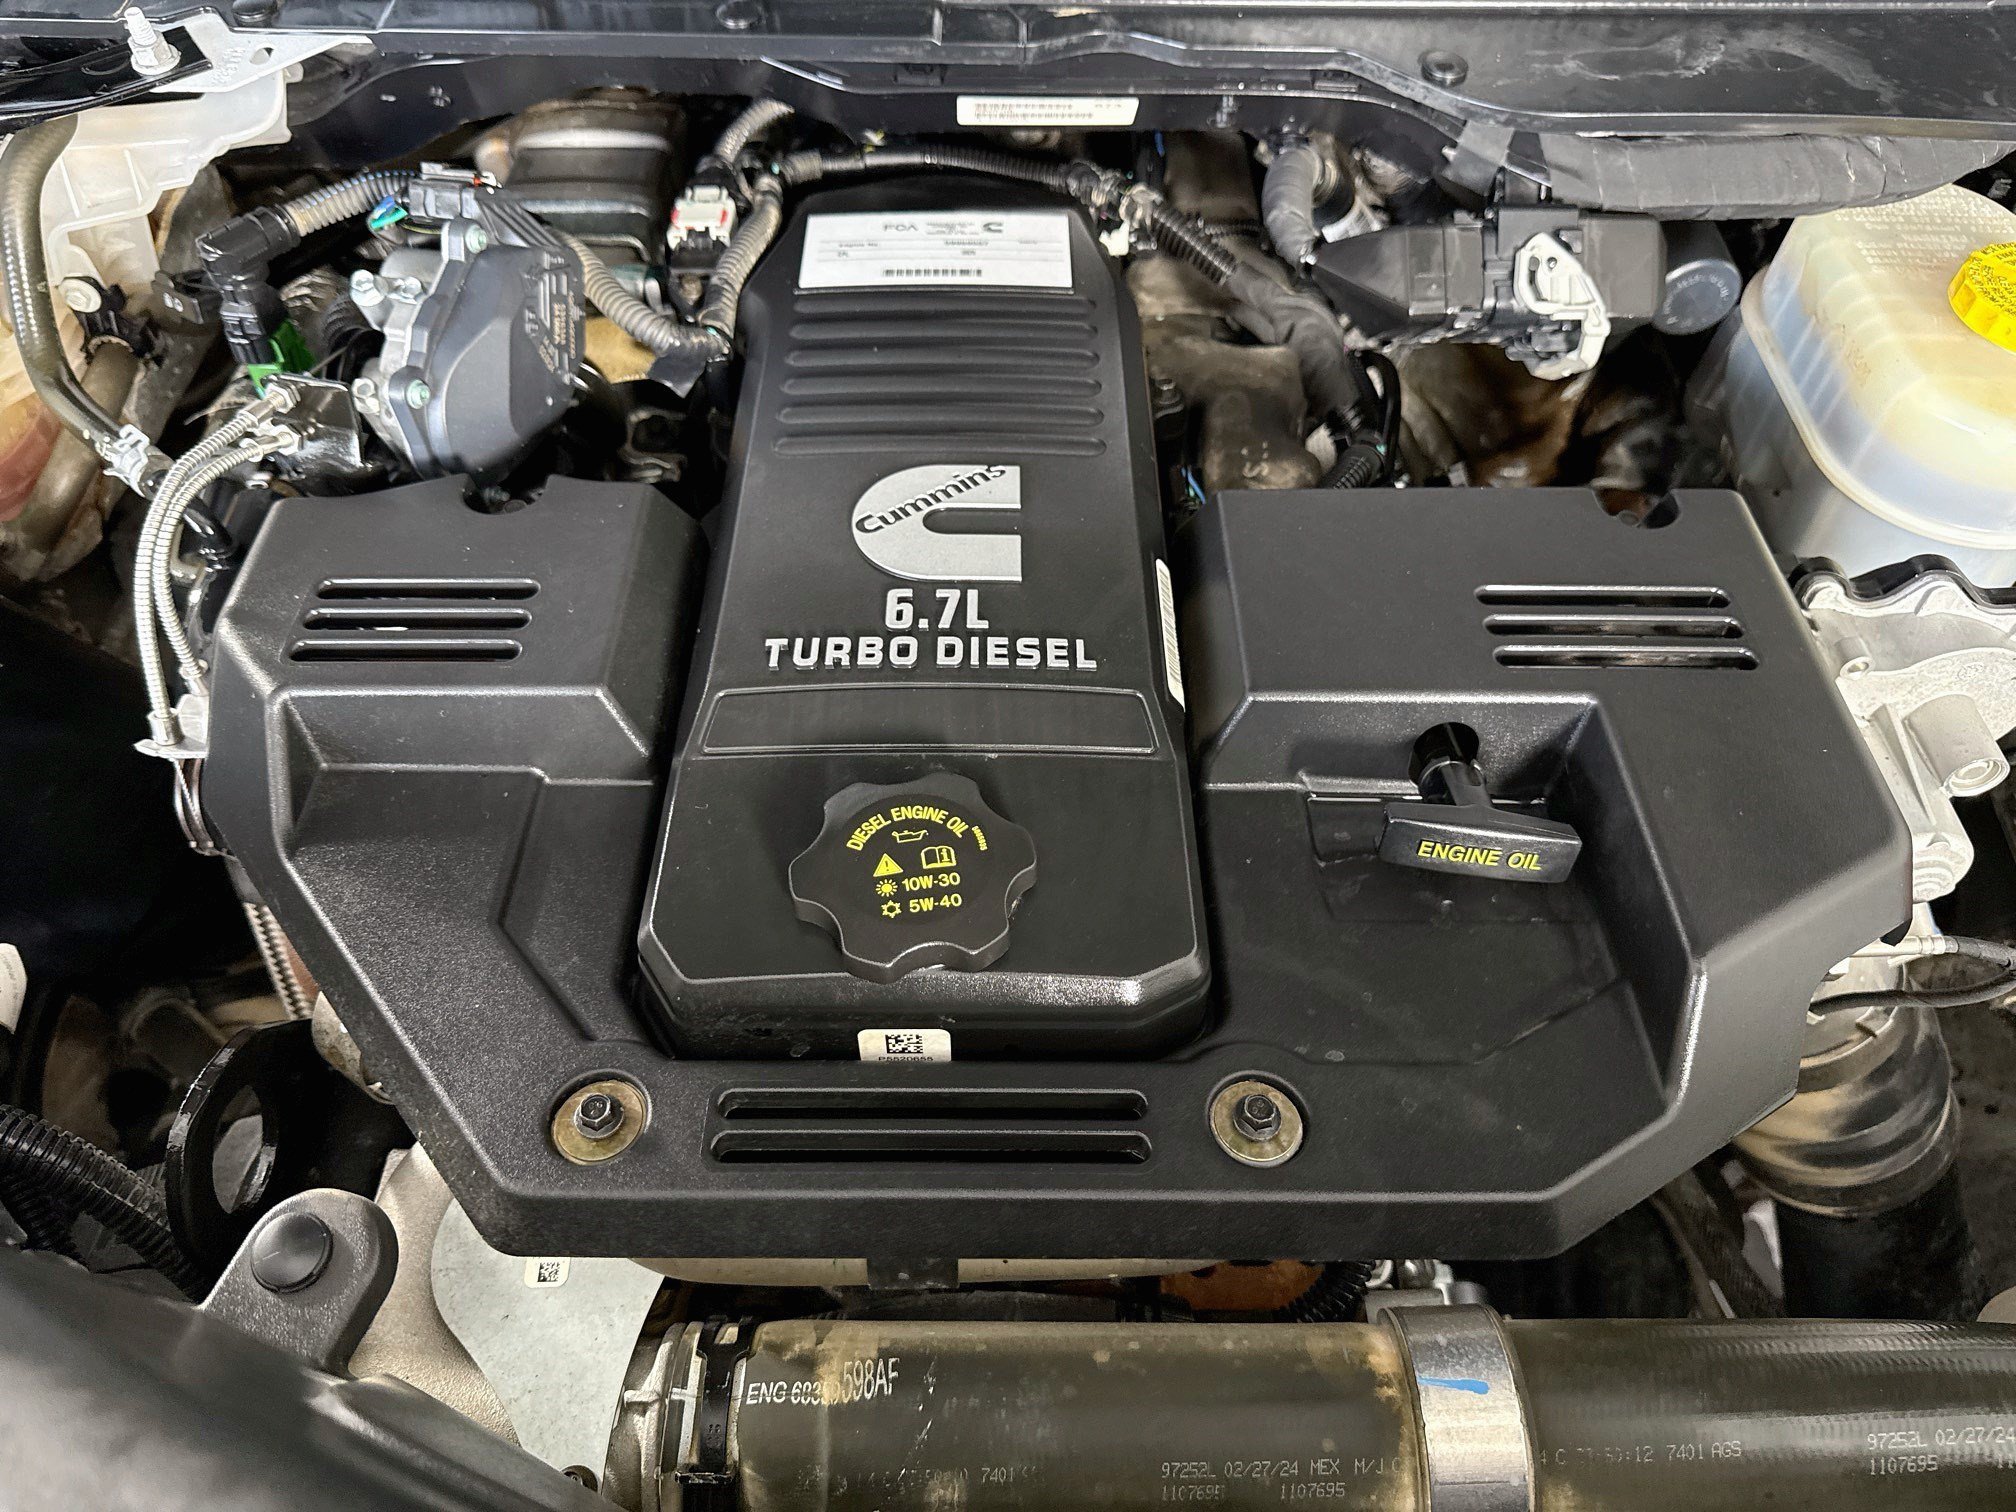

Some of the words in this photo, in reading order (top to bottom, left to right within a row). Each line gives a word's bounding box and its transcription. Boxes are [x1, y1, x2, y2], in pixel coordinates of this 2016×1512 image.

[855, 465, 1006, 534] Cummins
[884, 588, 990, 631] 6.7L
[764, 636, 918, 670] TURBO
[937, 636, 1098, 671] DIESEL
[846, 813, 892, 851] DIESEL
[890, 805, 949, 824] ENGINE
[946, 816, 970, 838] OIL
[1417, 839, 1503, 867] ENGINE
[1506, 851, 1542, 871] OIL
[901, 872, 961, 892] 10W-30
[909, 893, 963, 913] 5W-40
[746, 1381, 788, 1405] ENG
[1666, 1443, 1704, 1462] 7401
[1711, 1440, 1742, 1459] AGS
[1867, 1430, 1928, 1450] 97252L
[1224, 1459, 1299, 1478] 02/27/24
[1310, 1457, 1340, 1475] MEX
[1354, 1457, 1385, 1476] M/J
[1870, 1454, 1939, 1476] 1107695
[1280, 1482, 1346, 1499] 1107695
